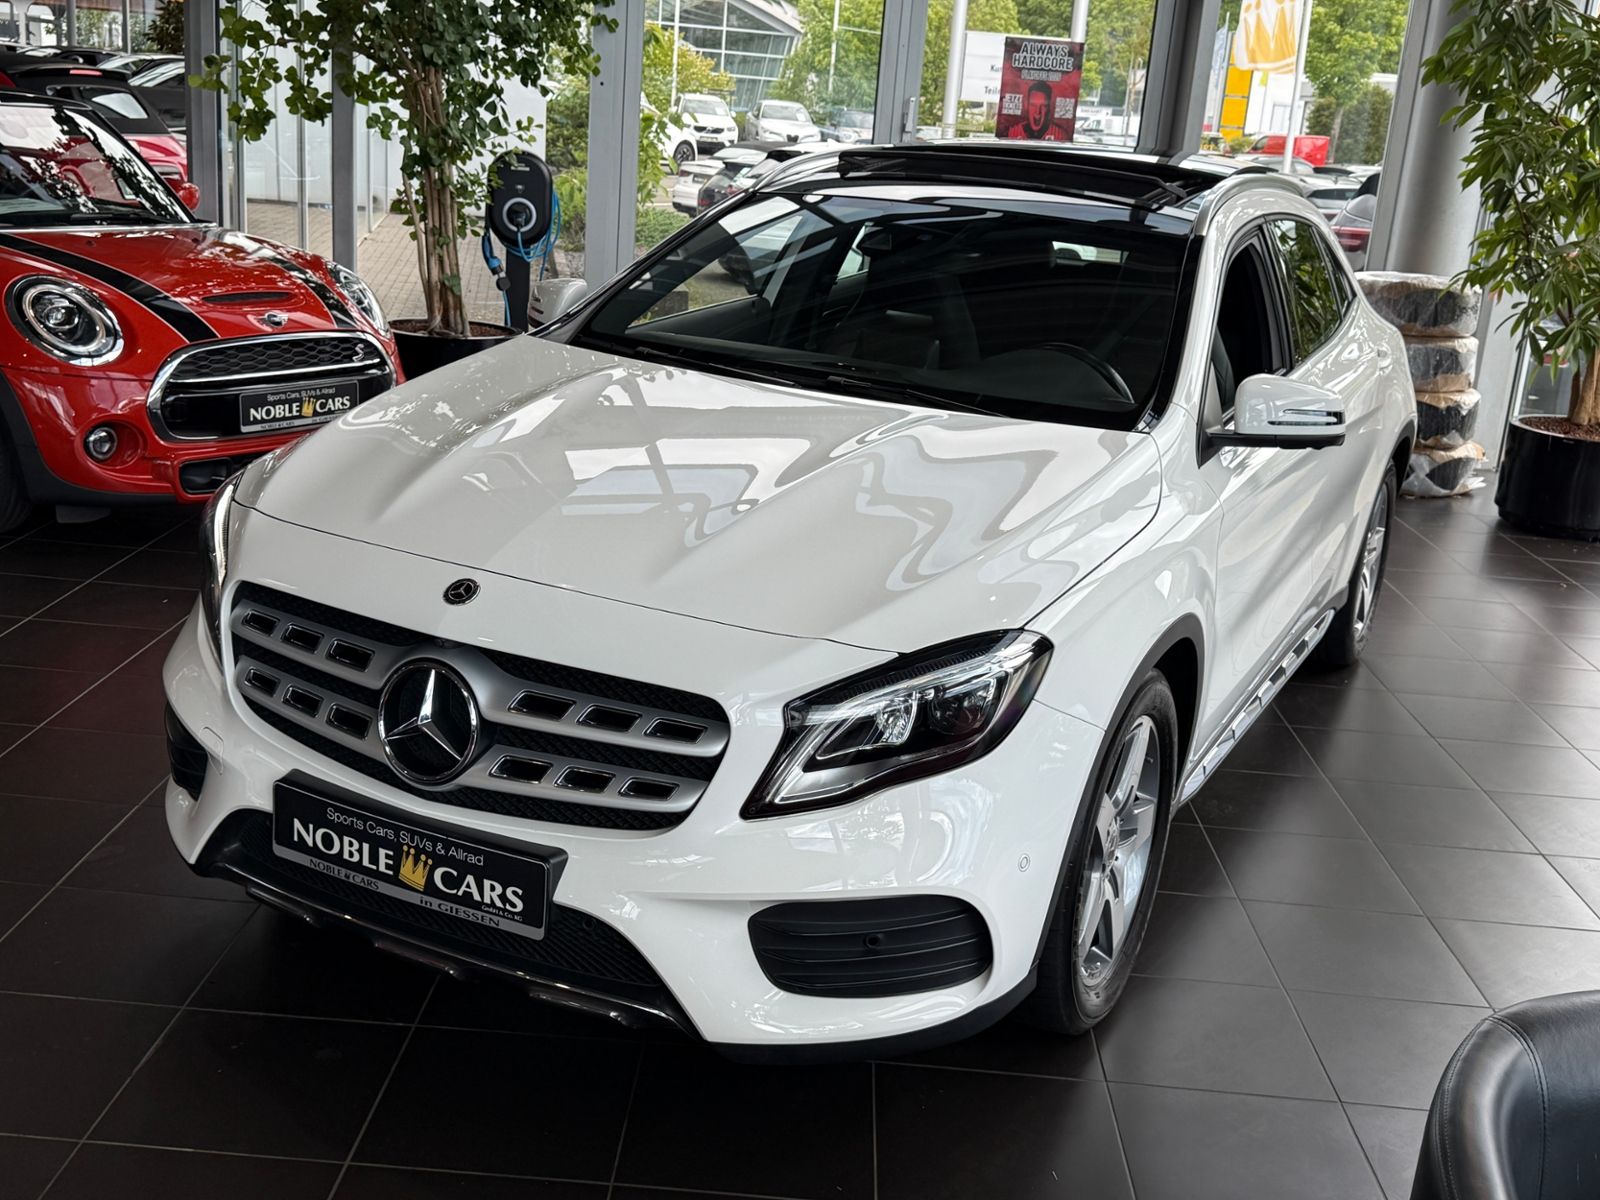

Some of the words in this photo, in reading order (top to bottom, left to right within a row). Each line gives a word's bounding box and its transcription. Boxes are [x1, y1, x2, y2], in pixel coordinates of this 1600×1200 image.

[1012, 53, 1074, 71] HARDCORE
[1021, 42, 1069, 58] ALWAYS
[249, 402, 300, 422] NOBLE
[315, 396, 351, 413] CARS
[267, 393, 286, 402] Sports
[326, 807, 364, 830] Sports
[366, 821, 398, 843] Cars,
[400, 831, 433, 852] SUVs
[436, 842, 446, 856] &
[448, 846, 484, 866] Allrad
[293, 817, 394, 876] NOBLE
[433, 866, 524, 913] CARS
[309, 858, 343, 878] NOBLE
[352, 874, 380, 890] CARS
[420, 896, 433, 907] in
[438, 903, 500, 927] GIESSEN
